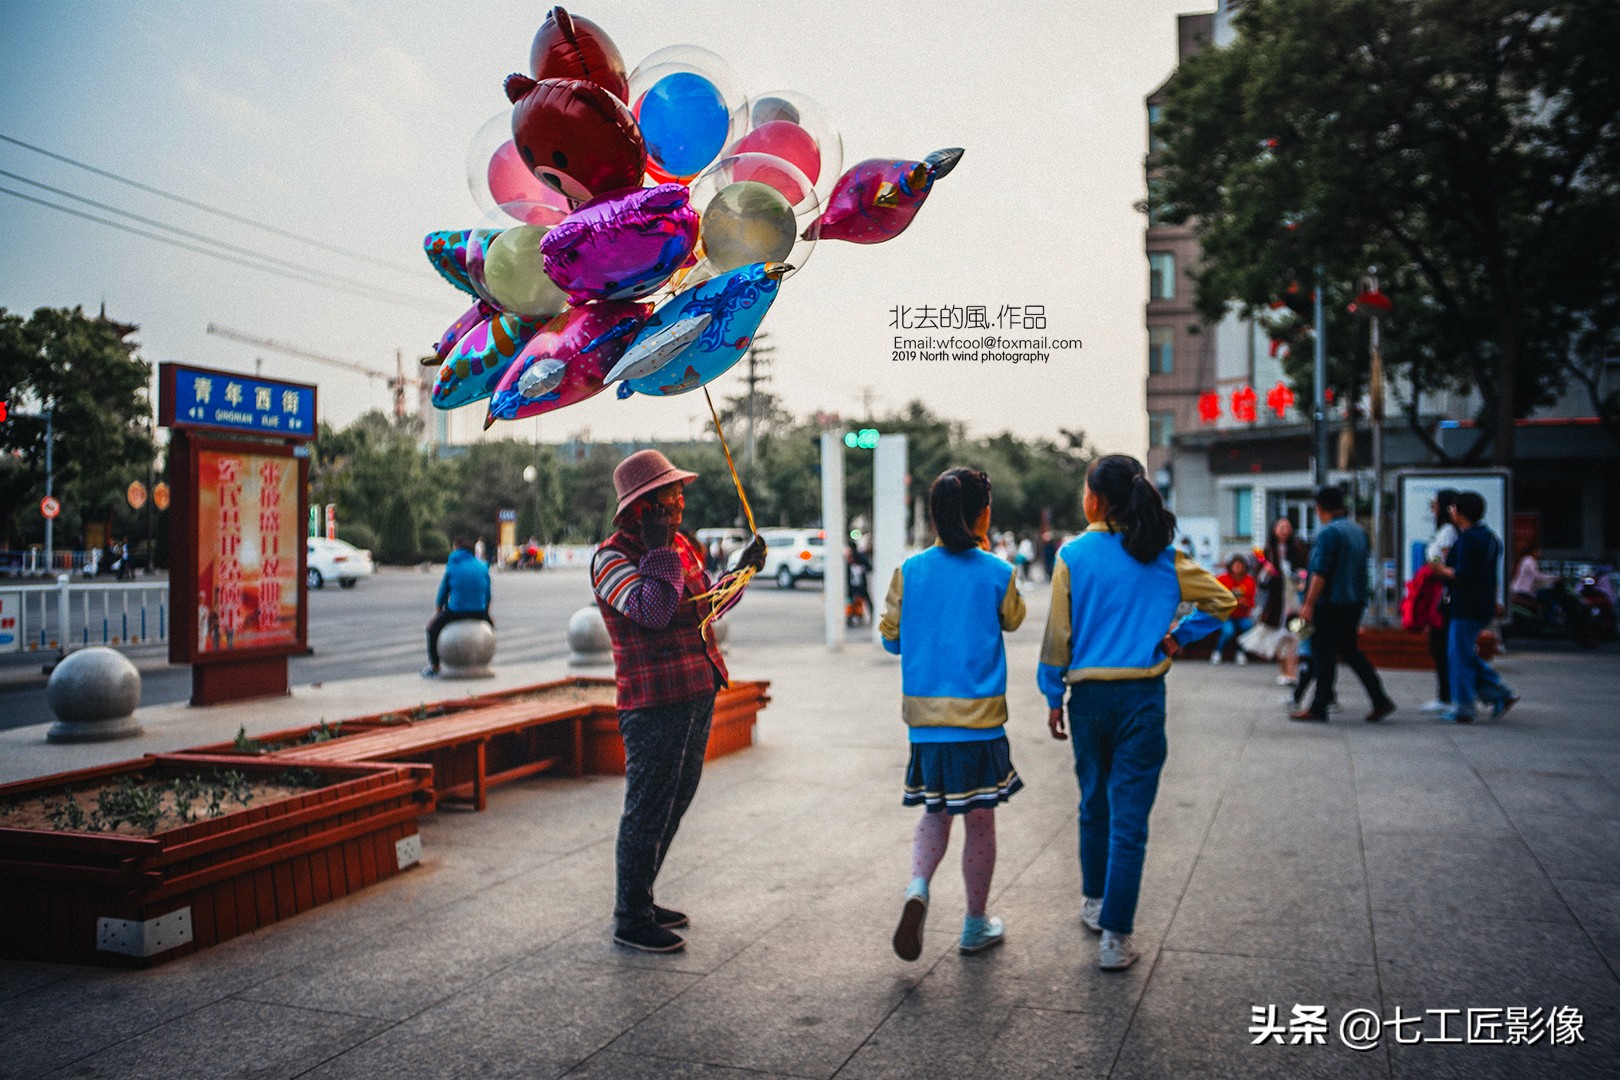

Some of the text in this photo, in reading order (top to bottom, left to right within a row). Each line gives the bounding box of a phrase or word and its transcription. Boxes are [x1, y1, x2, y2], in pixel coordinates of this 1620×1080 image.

[194, 377, 299, 414] 青年西街
[215, 408, 253, 425] QINGNIAN
